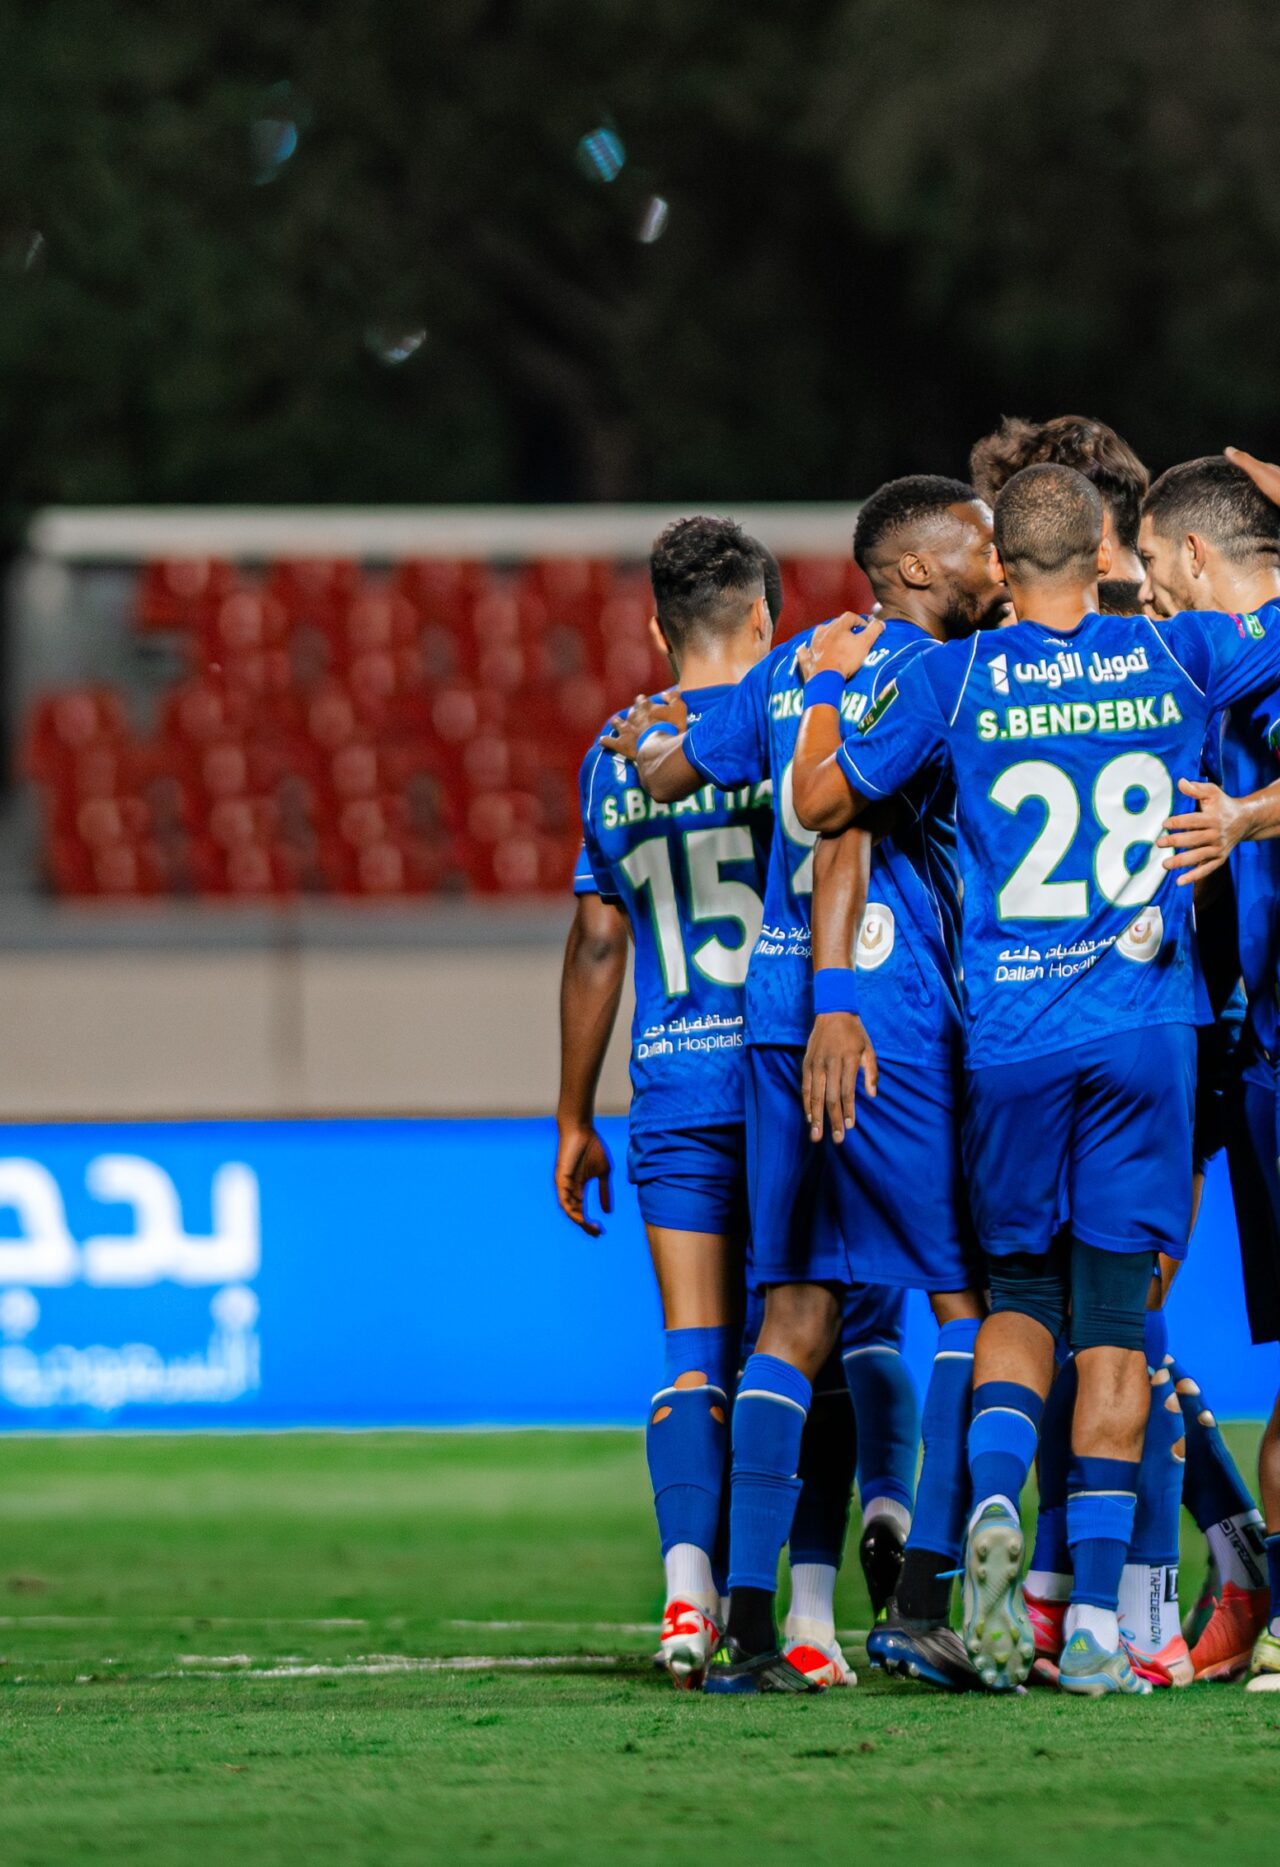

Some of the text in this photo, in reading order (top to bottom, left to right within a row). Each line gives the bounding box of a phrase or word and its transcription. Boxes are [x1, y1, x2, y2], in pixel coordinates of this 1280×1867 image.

[1014, 646, 1149, 689] تمويل الأولى
[978, 692, 1182, 741] S.BENDEBKA
[988, 751, 1174, 922] 28
[618, 824, 764, 999] 15
[994, 965, 1045, 982] Dallah
[678, 1031, 744, 1053] Hospitals
[1150, 1568, 1162, 1645] TAPEDESIGN
